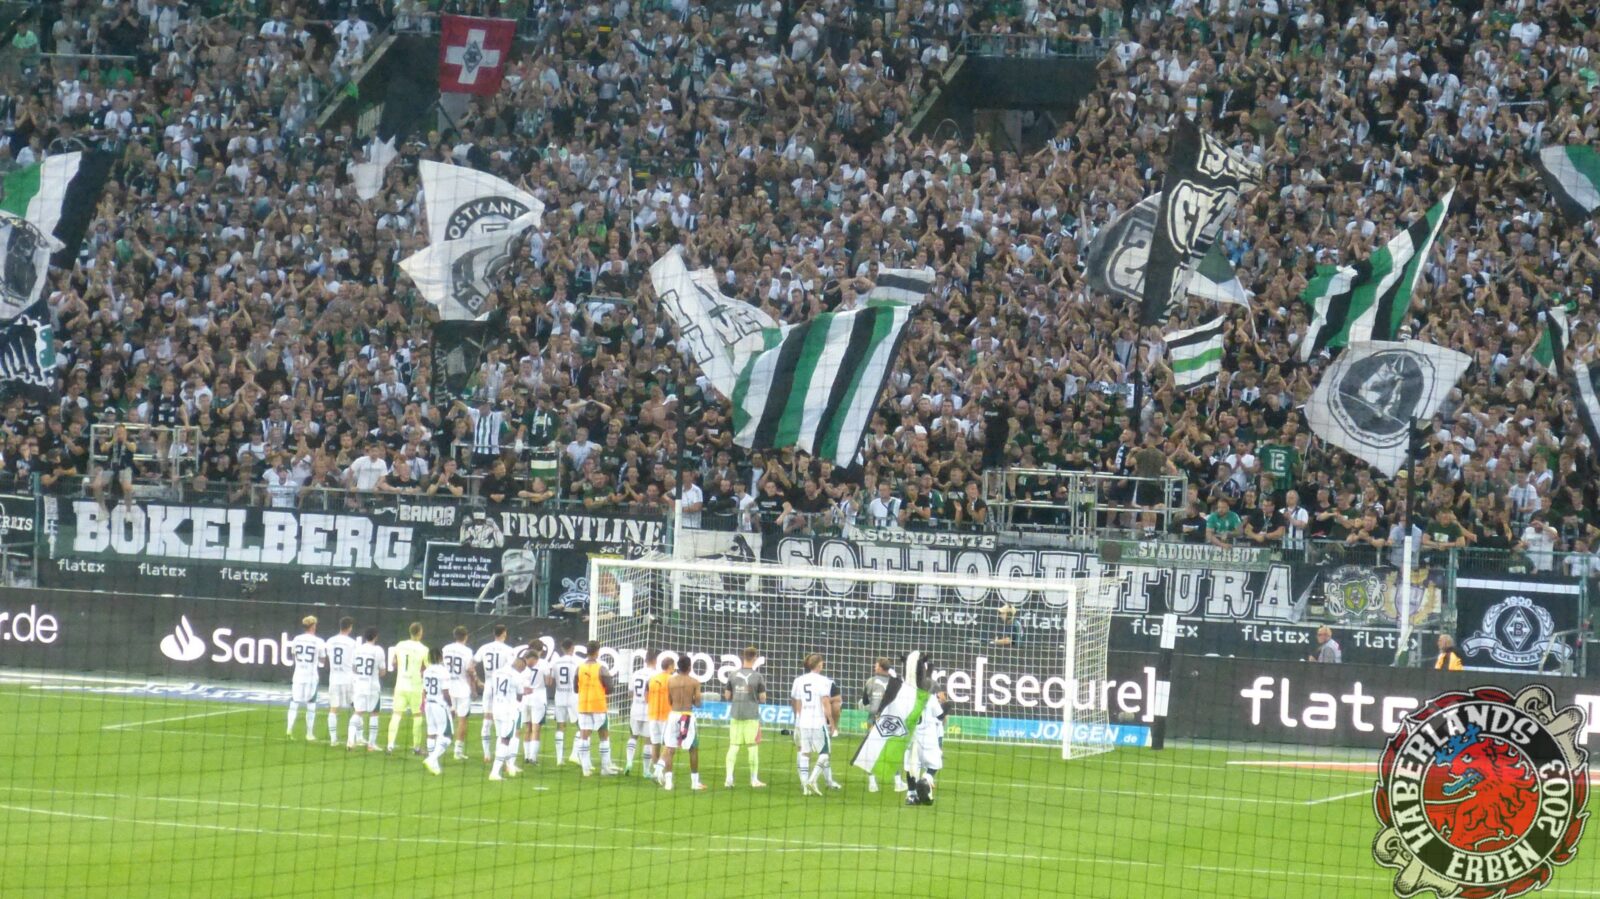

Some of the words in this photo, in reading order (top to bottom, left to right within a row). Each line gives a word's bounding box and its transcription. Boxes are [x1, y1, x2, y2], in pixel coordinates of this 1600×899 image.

[1271, 453, 1285, 470] 12
[400, 504, 456, 522] BANDA
[501, 511, 663, 546] FRONTLINE
[850, 528, 995, 549] ASCENDENTE
[1138, 540, 1261, 562] STADIONVERBOT
[57, 558, 105, 573] flatex
[138, 563, 186, 577] flatex
[220, 568, 268, 582] flatex
[302, 572, 350, 587] flatex
[777, 537, 1300, 623] SOTTOCULTURA
[1242, 625, 1310, 644] flatex
[295, 645, 315, 662] 25
[333, 647, 343, 665] 8
[405, 654, 409, 671] 1
[485, 652, 499, 671] 31
[356, 657, 374, 675] 28
[559, 666, 569, 684] 9
[530, 668, 538, 685] 7
[496, 677, 508, 696] 14
[635, 678, 643, 696] 2
[804, 683, 812, 701] 5
